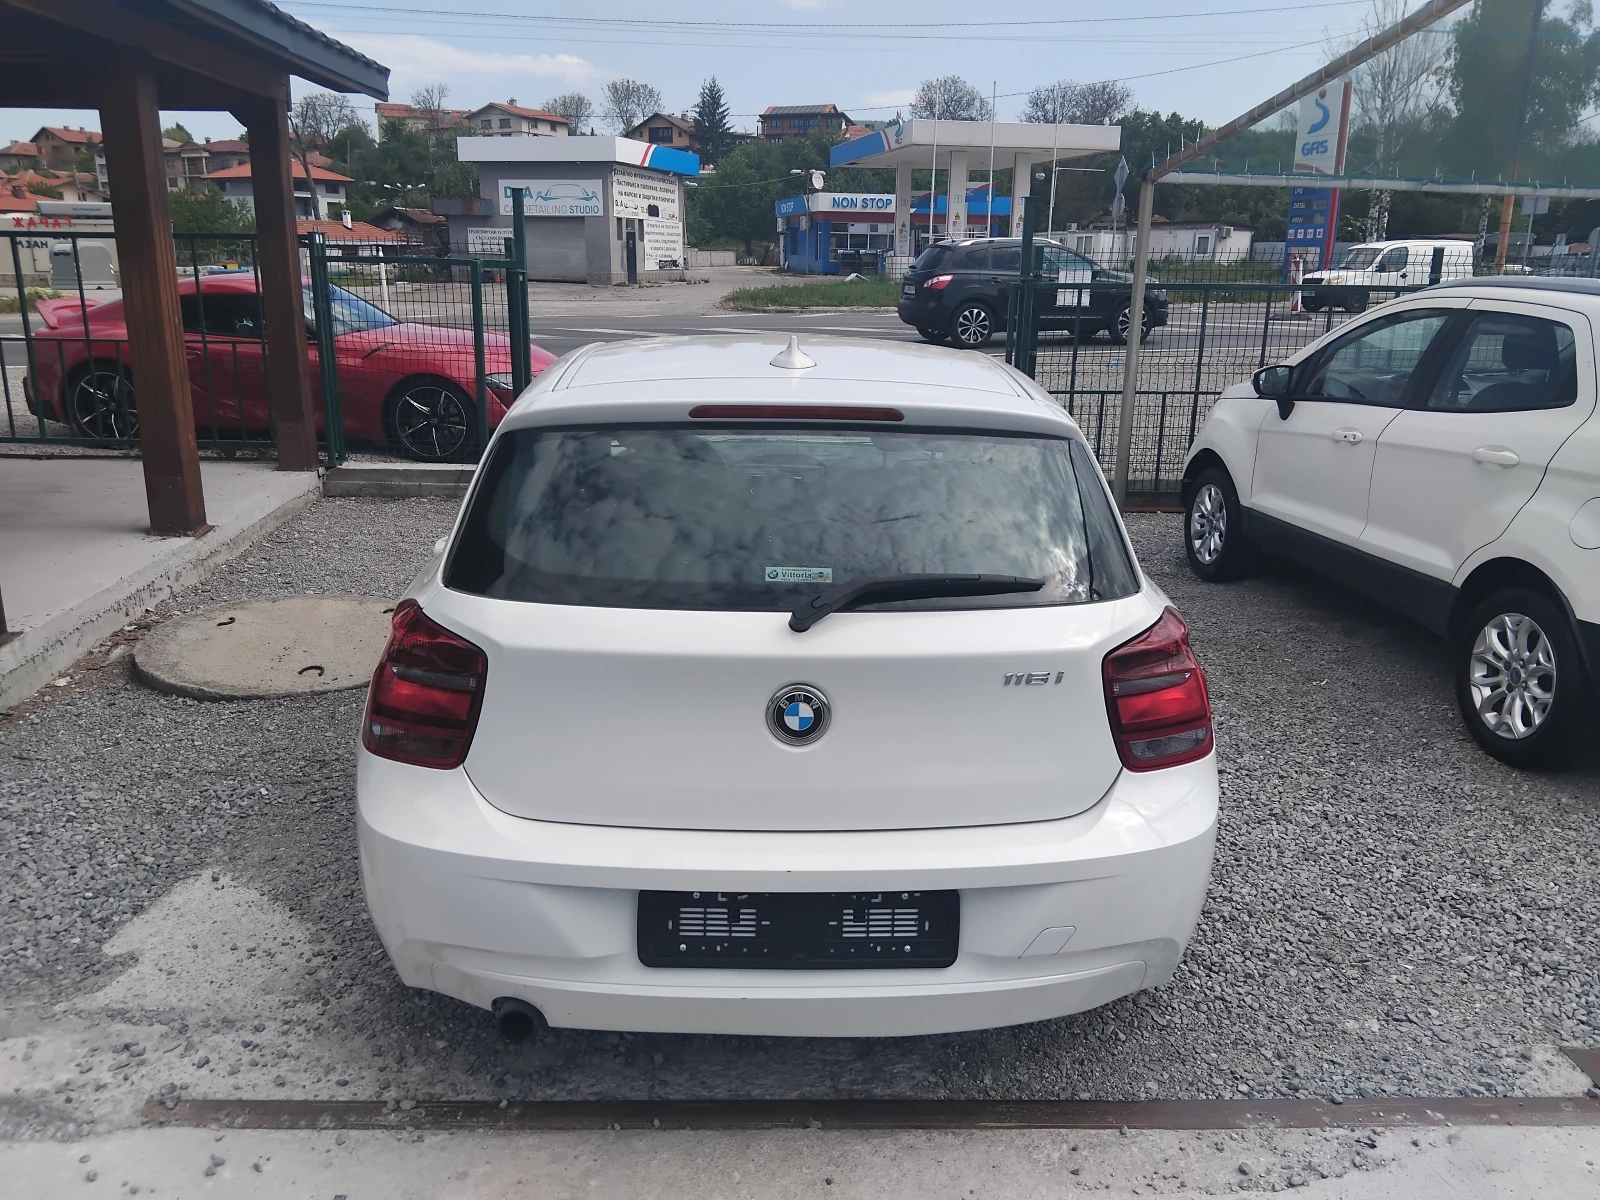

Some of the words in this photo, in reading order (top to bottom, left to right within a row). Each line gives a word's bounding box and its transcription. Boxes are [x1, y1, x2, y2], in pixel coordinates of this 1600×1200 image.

[1302, 140, 1328, 156] GAS
[524, 204, 568, 215] DETAILING
[569, 205, 600, 215] STUDIO
[832, 196, 858, 209] NON
[861, 196, 893, 210] STOP
[779, 693, 820, 710] BMW
